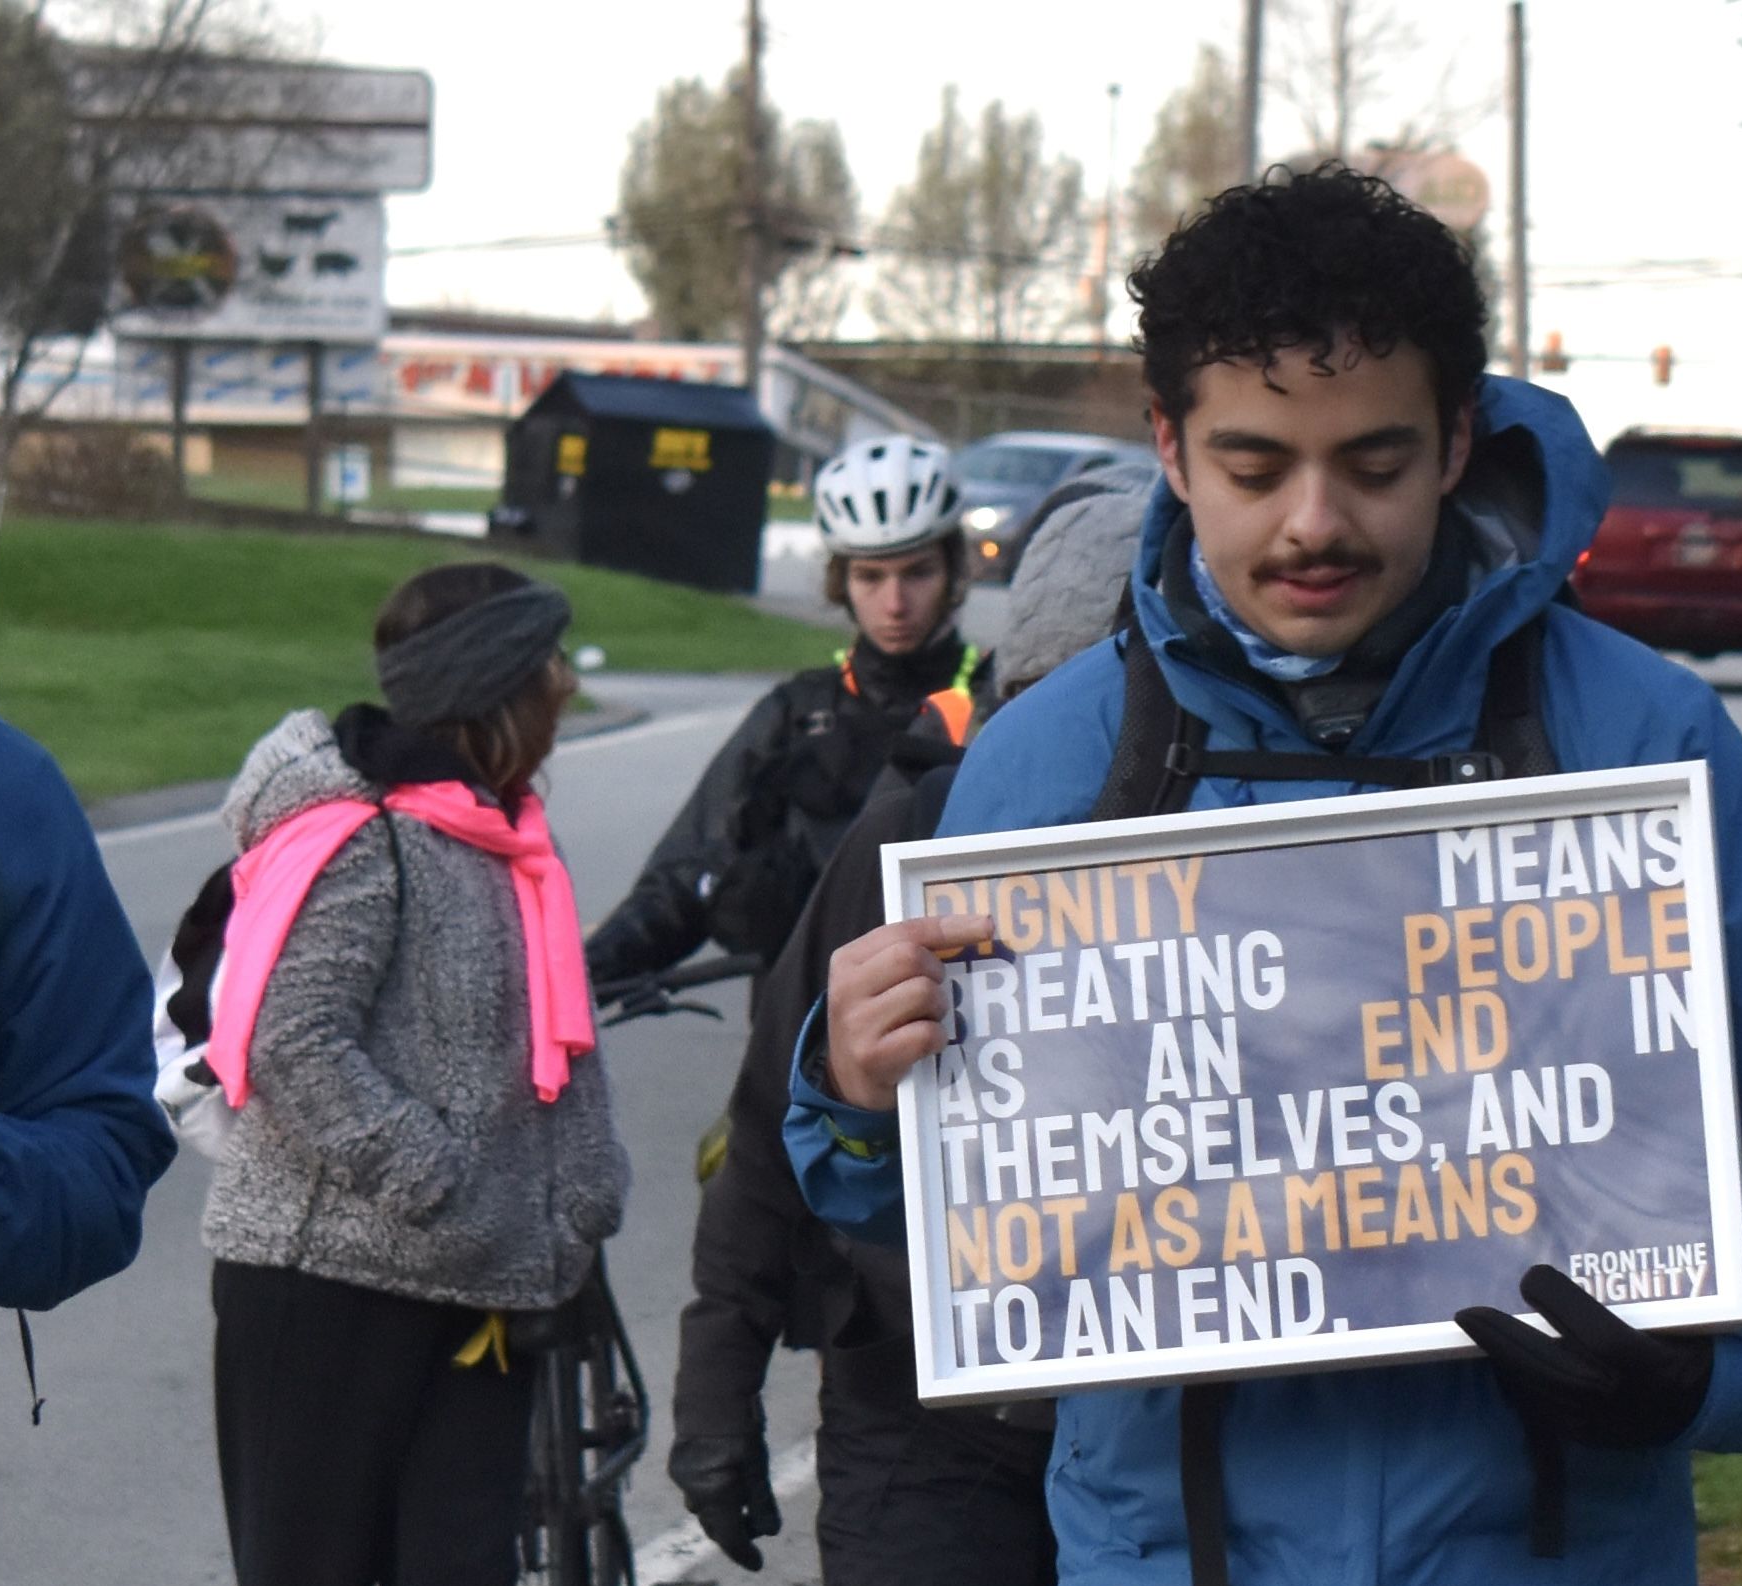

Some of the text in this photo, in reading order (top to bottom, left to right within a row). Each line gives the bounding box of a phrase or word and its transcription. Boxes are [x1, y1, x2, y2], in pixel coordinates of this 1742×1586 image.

[925, 810, 1684, 959] DIGNITY MEANS
[943, 888, 1692, 1042] TREATING PEOPLE
[939, 970, 1699, 1122] AS AN END IN
[942, 1063, 1614, 1204] THEMSELVES, AND
[947, 1154, 1538, 1287] NOT AS A MEANS
[1570, 1242, 1707, 1277] FRONTLINE
[952, 1257, 1349, 1367] TO AN END.
